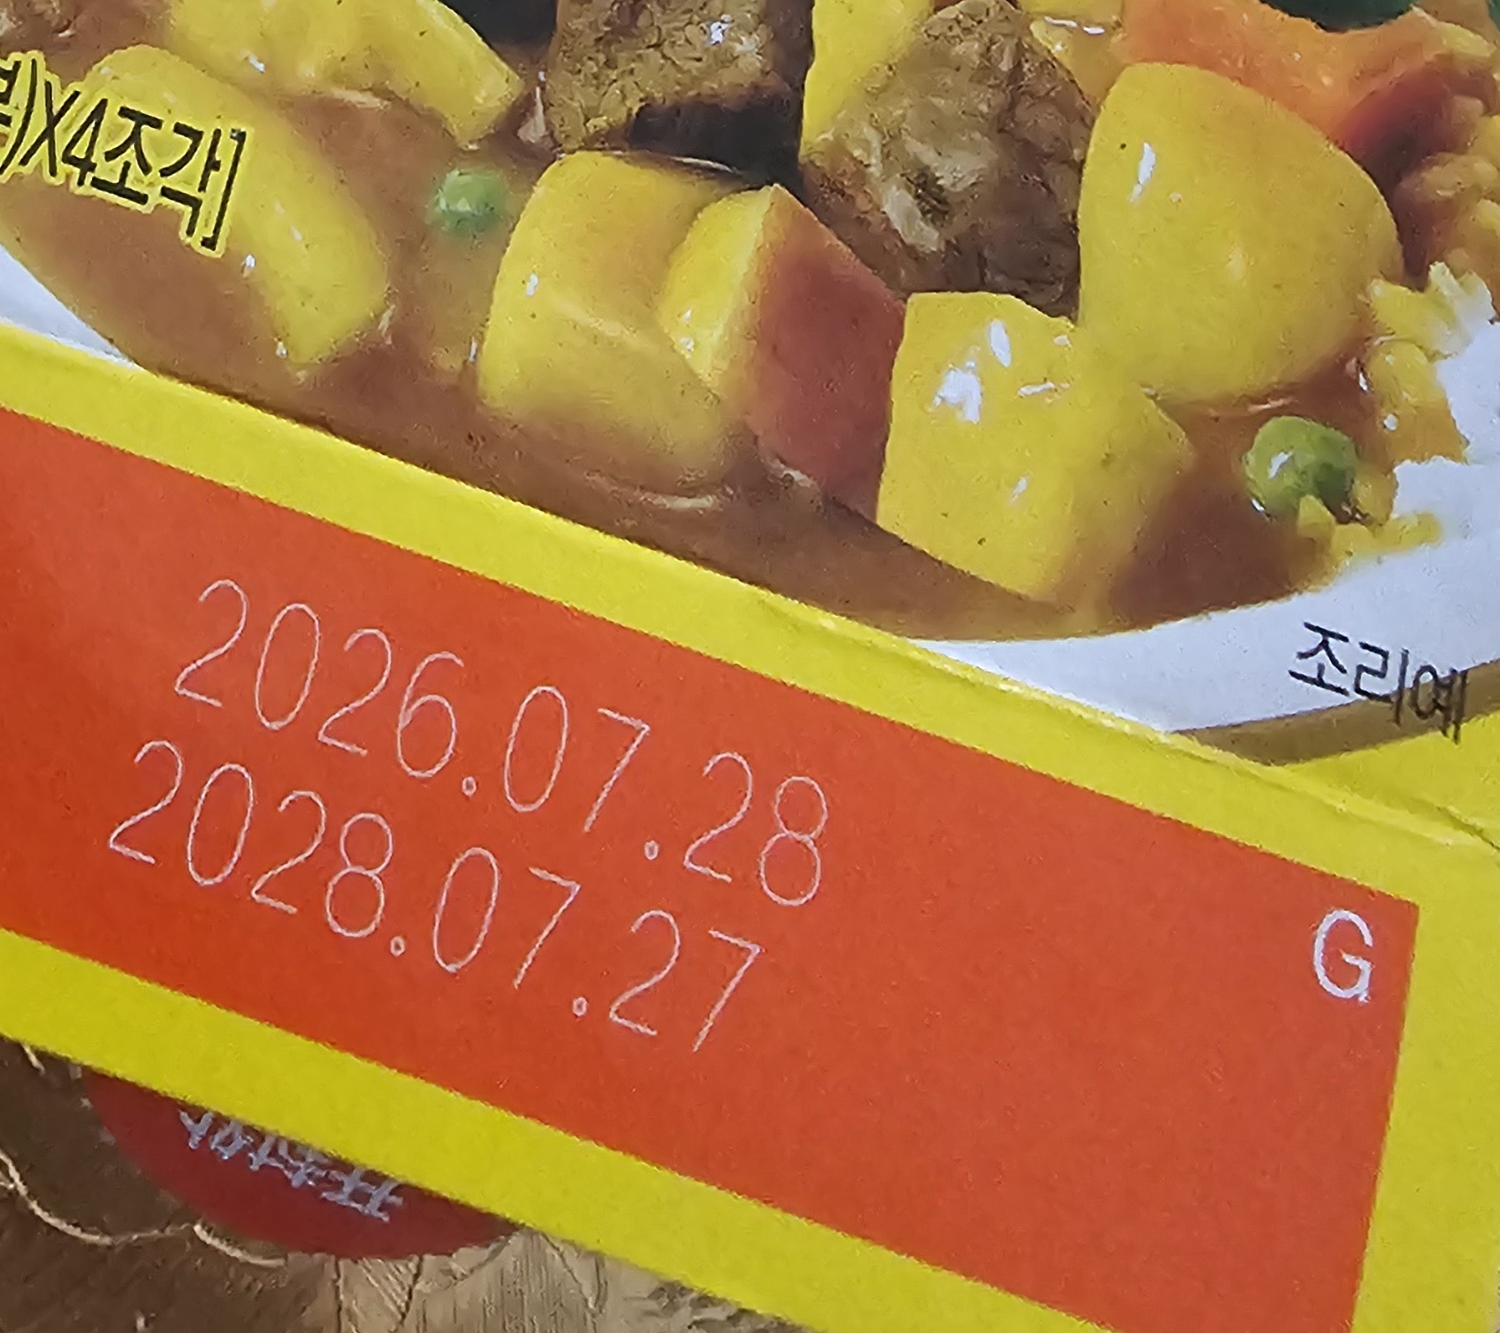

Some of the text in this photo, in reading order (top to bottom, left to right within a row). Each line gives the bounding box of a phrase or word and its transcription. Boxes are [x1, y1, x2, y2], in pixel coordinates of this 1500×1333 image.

[174, 578, 829, 907] 2026.07.28
[1287, 621, 1469, 745] 조리예
[108, 740, 762, 1053] 2028.07.27
[1312, 908, 1374, 1004] G
